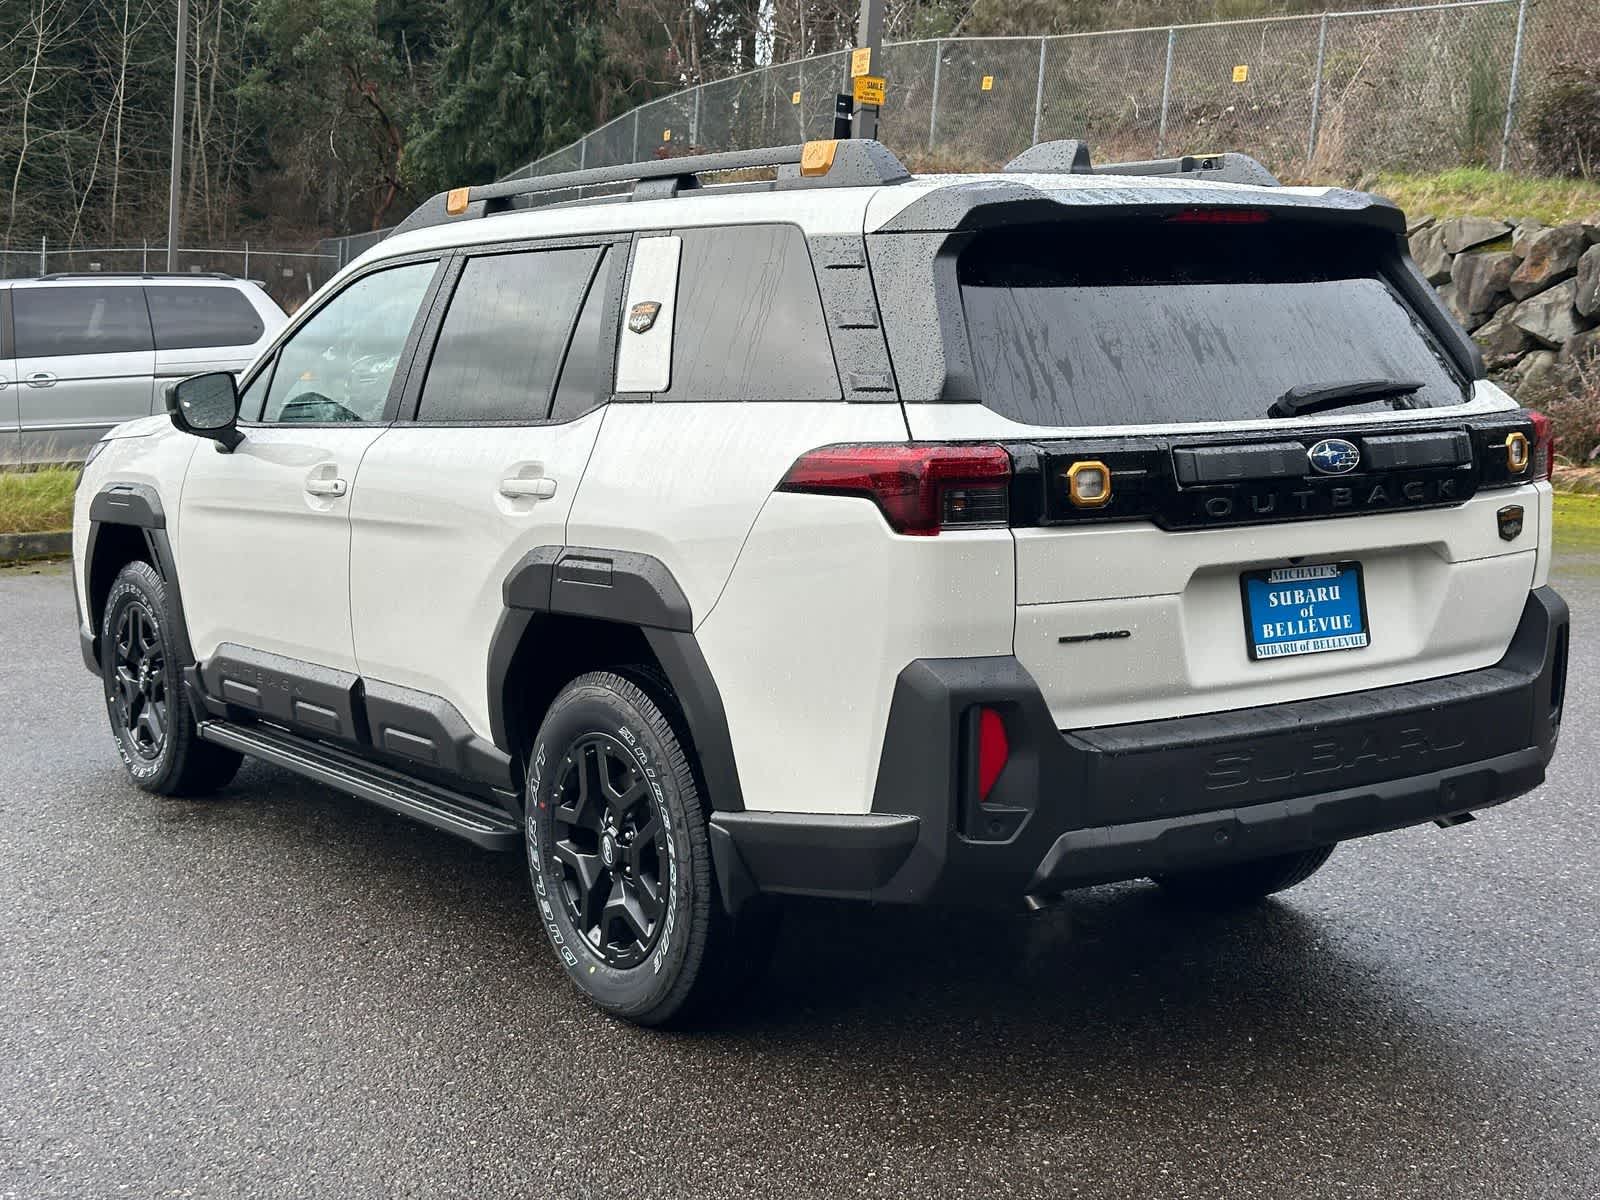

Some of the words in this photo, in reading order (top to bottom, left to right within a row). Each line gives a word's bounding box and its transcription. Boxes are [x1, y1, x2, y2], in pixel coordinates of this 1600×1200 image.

[1204, 478, 1456, 517] OUTBACK
[1272, 565, 1336, 580] MICHAEL'S
[1268, 585, 1341, 608] SUBARU
[1300, 604, 1314, 618] of
[1262, 614, 1353, 639] BELLEVUE
[1256, 643, 1298, 657] SUBARU
[1300, 640, 1311, 651] of
[1313, 634, 1366, 650] BELLEVUE
[1205, 726, 1466, 791] SUBARU
[528, 816, 578, 967] DUELER
